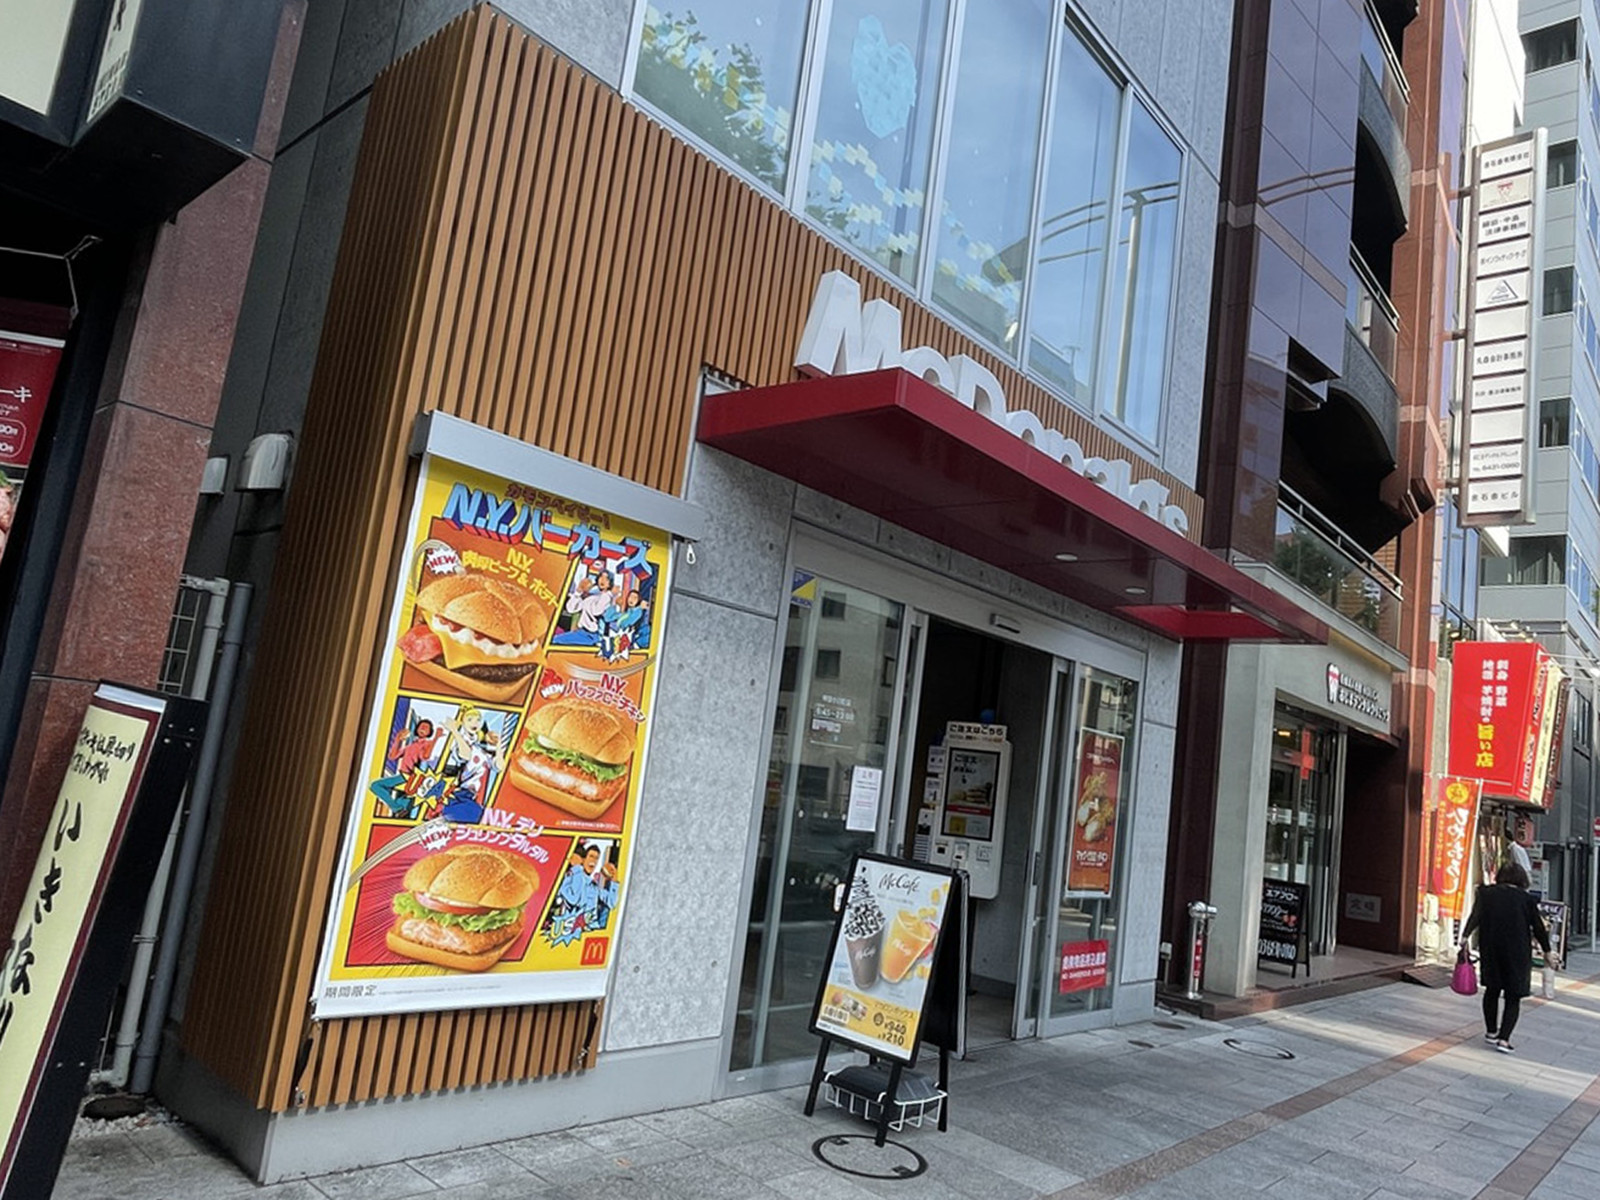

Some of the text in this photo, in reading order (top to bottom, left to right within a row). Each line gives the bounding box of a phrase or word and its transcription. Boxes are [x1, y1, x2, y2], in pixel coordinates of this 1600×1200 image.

[430, 555, 456, 568] NEW
[506, 547, 534, 574] N.Y.
[541, 684, 565, 698] NEW
[601, 673, 626, 695] N.Y.
[421, 830, 451, 847] NEW
[456, 824, 549, 863] シュリンプタルタル
[324, 985, 378, 998] 期間限定
